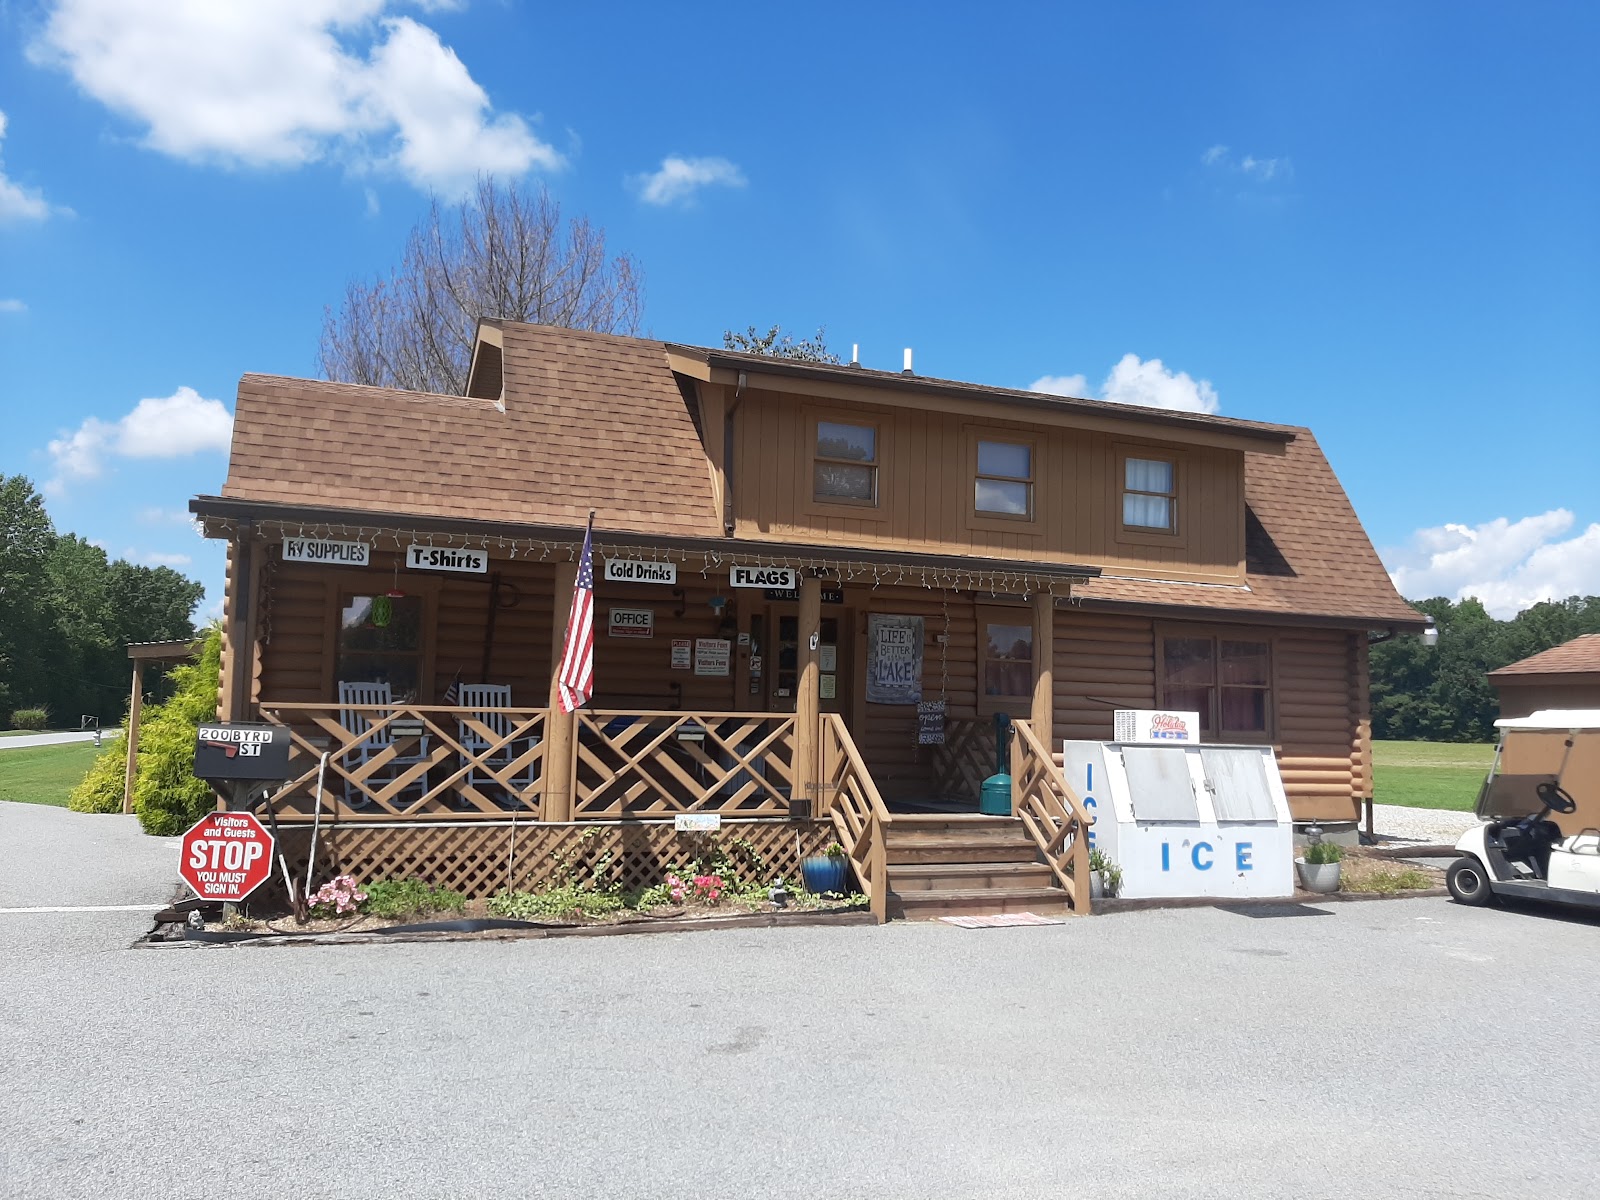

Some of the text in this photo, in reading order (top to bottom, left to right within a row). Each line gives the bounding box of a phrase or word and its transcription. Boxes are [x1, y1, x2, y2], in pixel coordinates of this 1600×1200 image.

[287, 541, 365, 562] RV SUPPLIES
[413, 549, 481, 569] T-Shirts
[610, 562, 671, 581] Cold Drinks
[736, 569, 790, 586] FLAGS
[774, 589, 835, 601] WELME
[614, 612, 649, 625] OFFICE
[880, 629, 906, 644] LIFE
[880, 644, 910, 656] BETTER
[879, 660, 912, 683] LAKE
[919, 714, 943, 725] open
[200, 729, 271, 742] 200 BYRD
[1152, 730, 1188, 740] ICE
[240, 743, 260, 755] ST
[214, 817, 249, 828] Visitors
[203, 827, 256, 839] and Guests
[189, 839, 263, 871] STOP
[1161, 842, 1253, 872] ICE
[196, 871, 247, 883] YOU MUST
[204, 883, 240, 895] SIGN IN.
